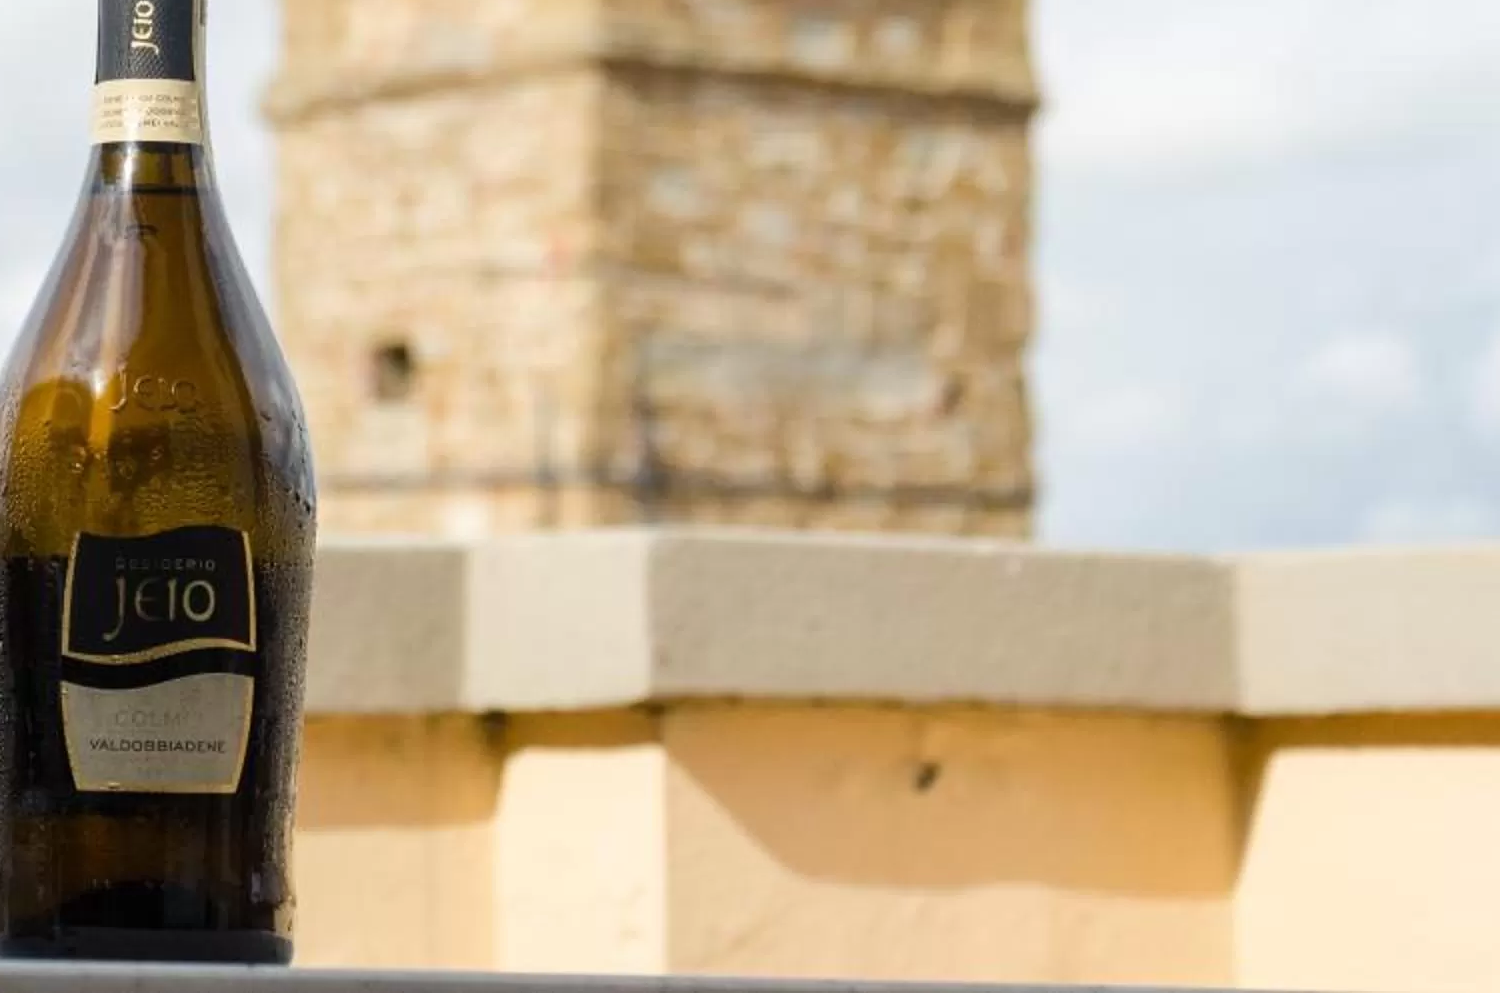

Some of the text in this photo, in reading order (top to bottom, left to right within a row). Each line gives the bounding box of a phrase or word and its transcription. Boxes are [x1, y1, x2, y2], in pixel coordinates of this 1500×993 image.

[131, 0, 159, 55] JEIO
[102, 576, 216, 641] JEIO
[90, 740, 226, 754] VALDOBBIADENE
